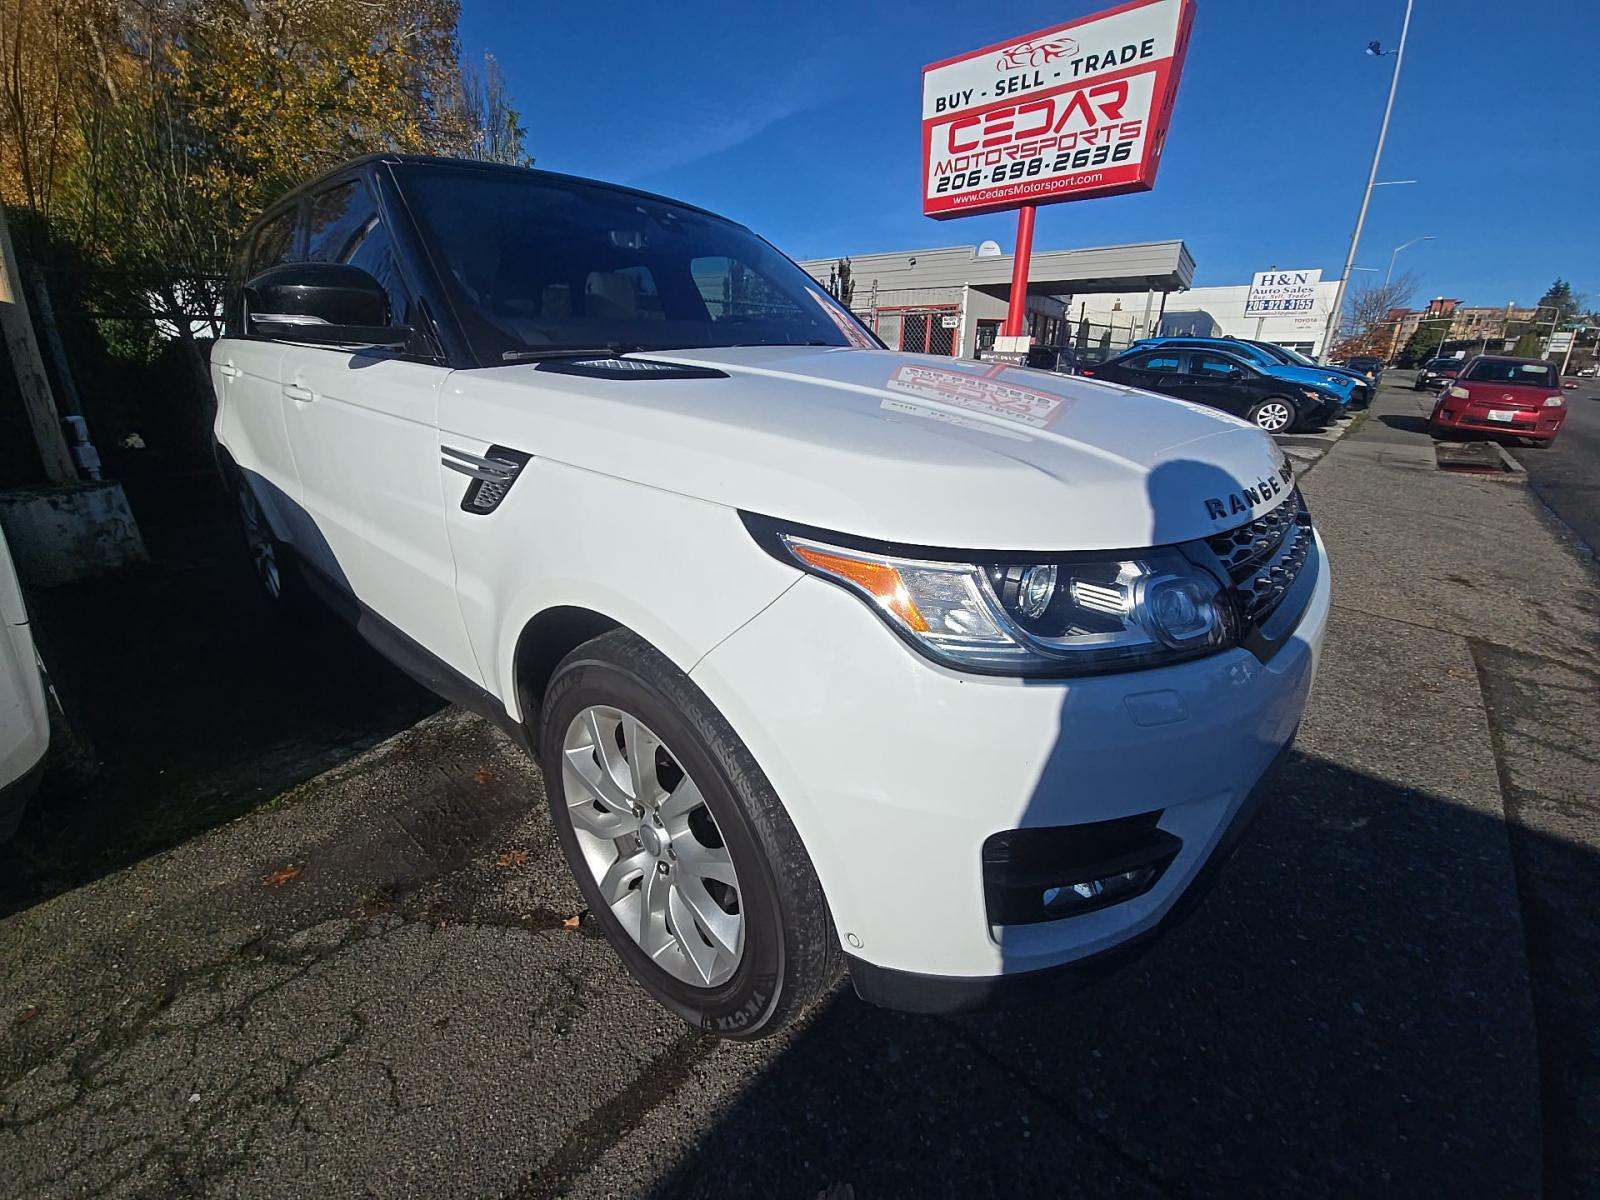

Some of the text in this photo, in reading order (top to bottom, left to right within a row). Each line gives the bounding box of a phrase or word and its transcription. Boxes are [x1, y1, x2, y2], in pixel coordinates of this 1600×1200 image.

[935, 88, 974, 113] BUY
[995, 70, 1045, 98] SELL
[1070, 38, 1155, 77] TRADE
[948, 80, 1129, 155] CEDAR
[934, 119, 1143, 177] MOTORSPORTS
[953, 172, 1103, 204] www.CedarsMotorsport.com
[1248, 300, 1312, 311] 206-928-3155
[1282, 285, 1315, 294] Sales
[1204, 475, 1281, 520] RANGE
